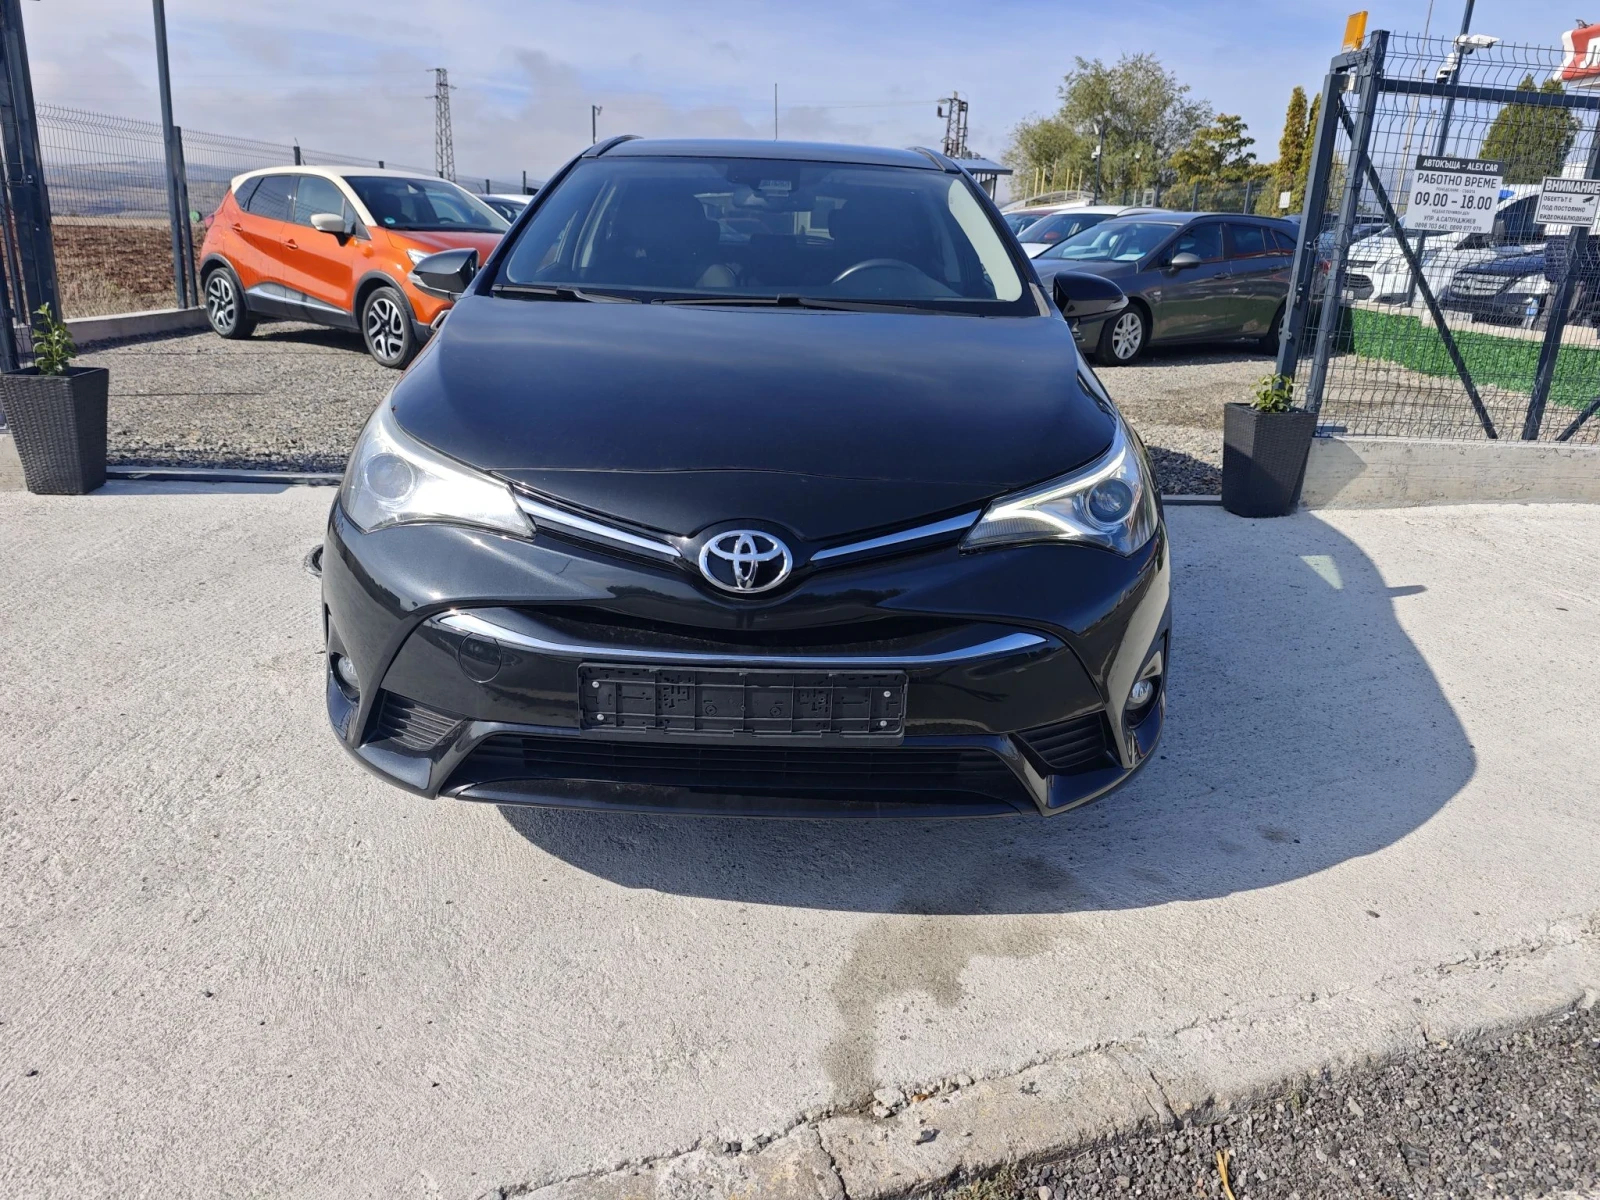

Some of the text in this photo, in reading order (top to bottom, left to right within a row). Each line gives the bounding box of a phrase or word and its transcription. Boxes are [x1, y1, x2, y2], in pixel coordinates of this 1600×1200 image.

[1422, 158, 1460, 170] АВТОКЪЩА
[1467, 162, 1484, 172] ALEX
[1484, 164, 1498, 172] CAR
[1417, 173, 1498, 188] РАБОТНО ВРЕМЕ
[1545, 180, 1600, 194] ВНИМАНИЕ
[1414, 192, 1448, 207] 09.00
[1460, 194, 1492, 210] 18.00
